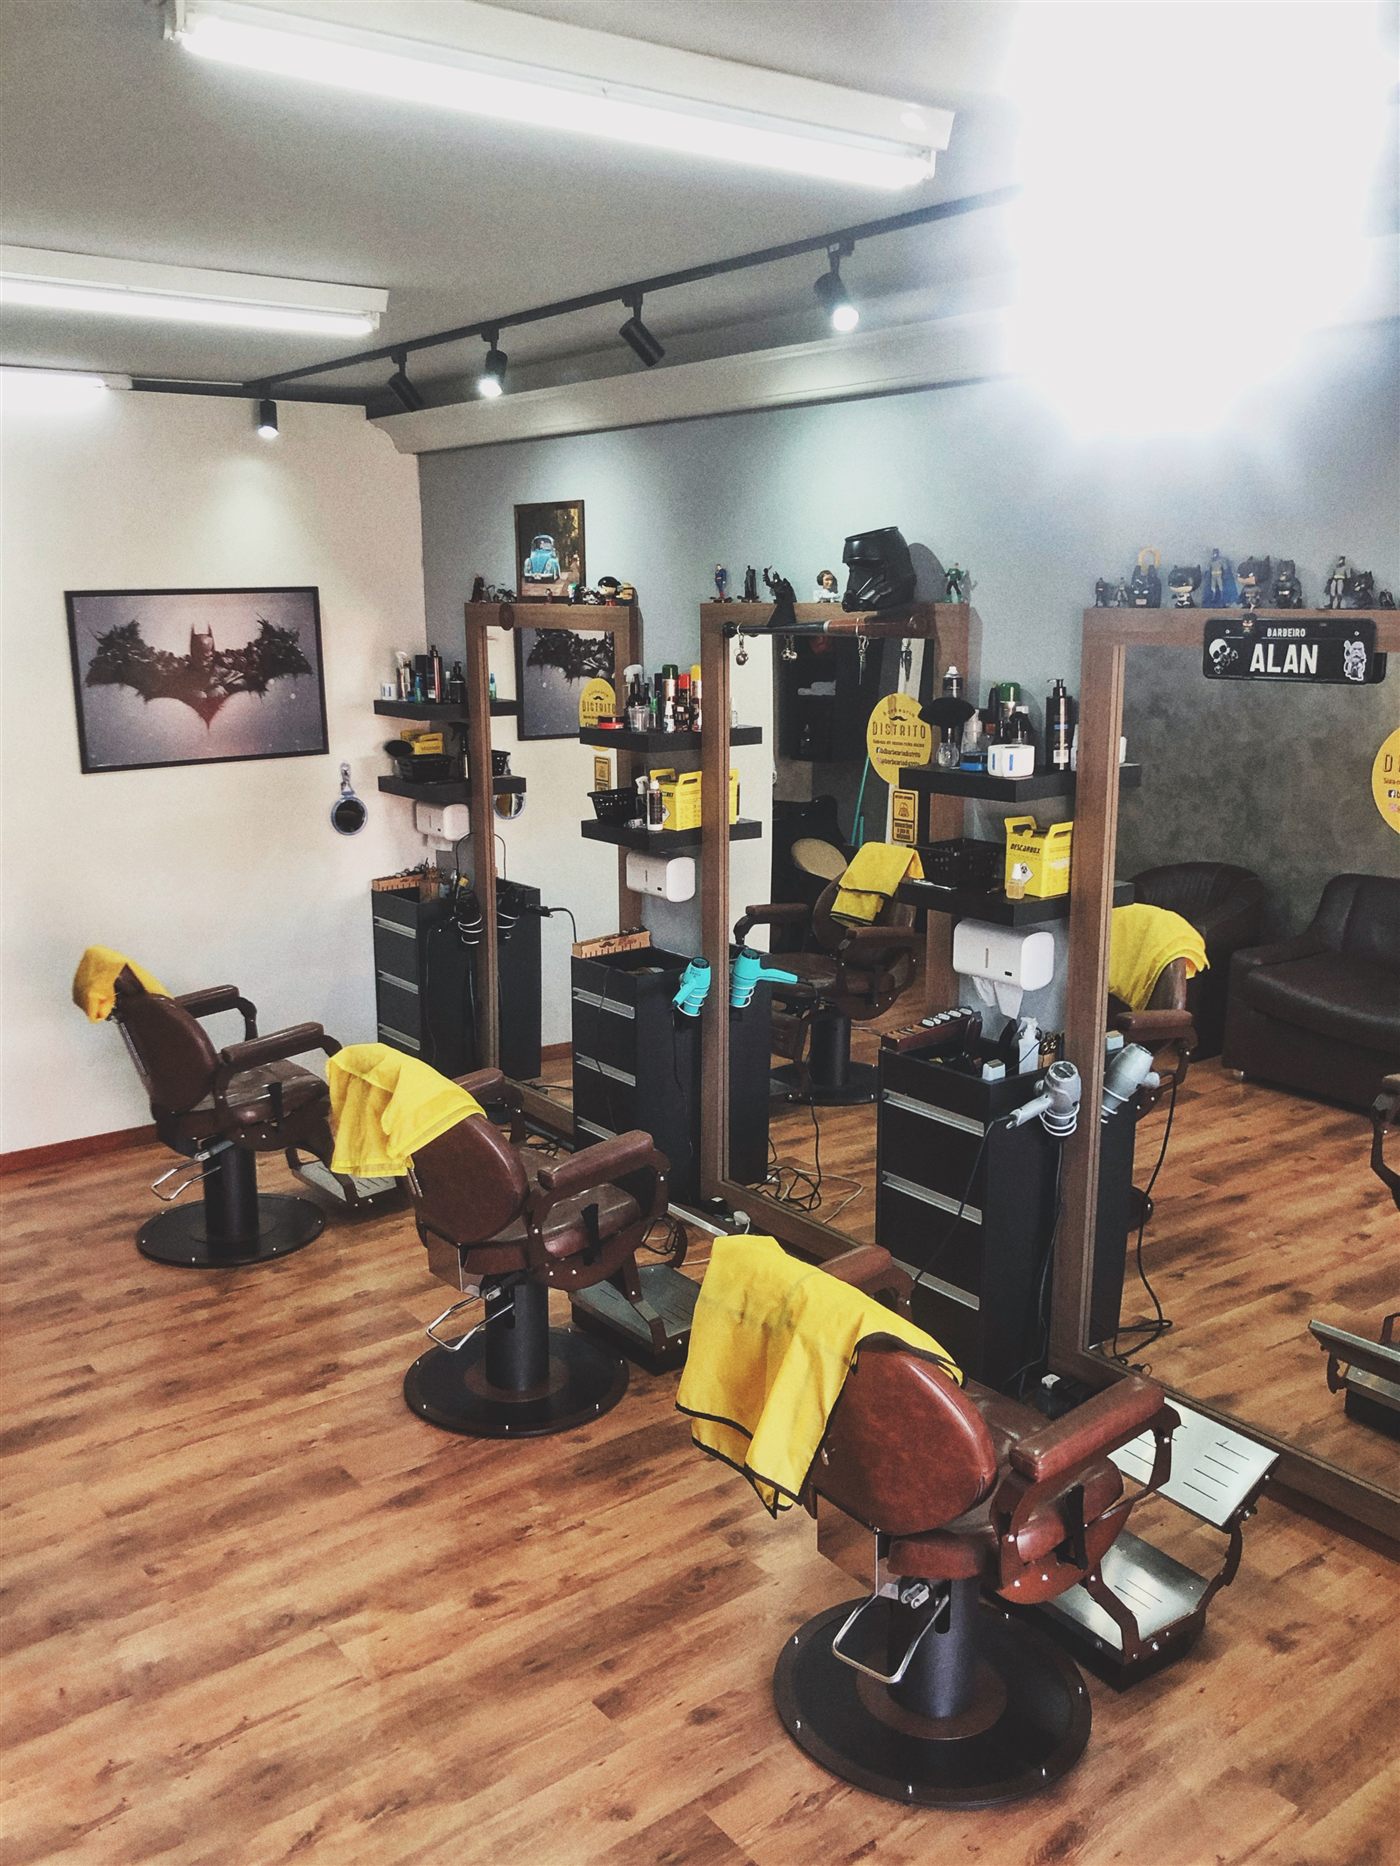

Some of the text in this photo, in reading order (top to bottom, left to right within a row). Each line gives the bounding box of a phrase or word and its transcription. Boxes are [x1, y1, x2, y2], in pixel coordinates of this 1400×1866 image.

[1266, 627, 1306, 638] BARBEIRO
[1249, 643, 1319, 675] ALAN
[872, 721, 926, 739] DISTRITO
